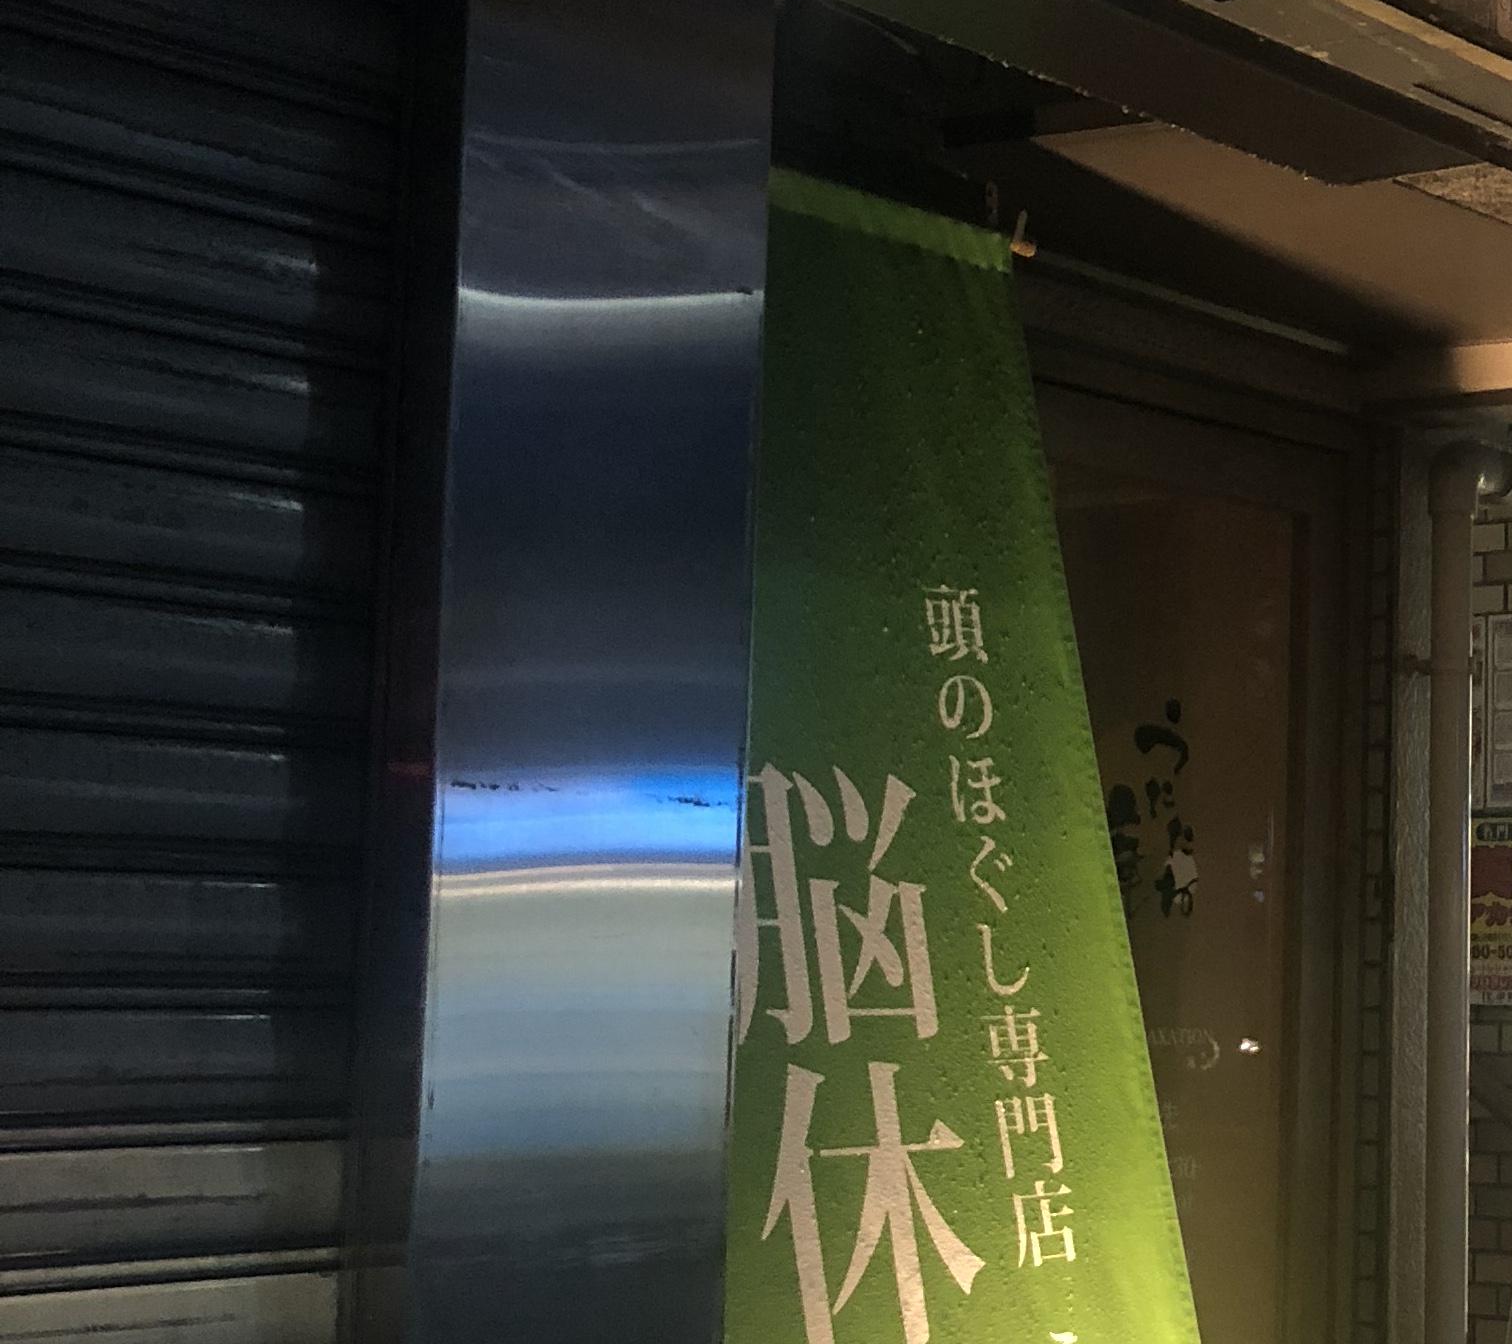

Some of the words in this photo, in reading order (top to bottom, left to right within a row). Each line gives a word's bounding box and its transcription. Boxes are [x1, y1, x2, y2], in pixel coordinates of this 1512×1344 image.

[924, 583, 1077, 1269] 頭のほぐし専門店
